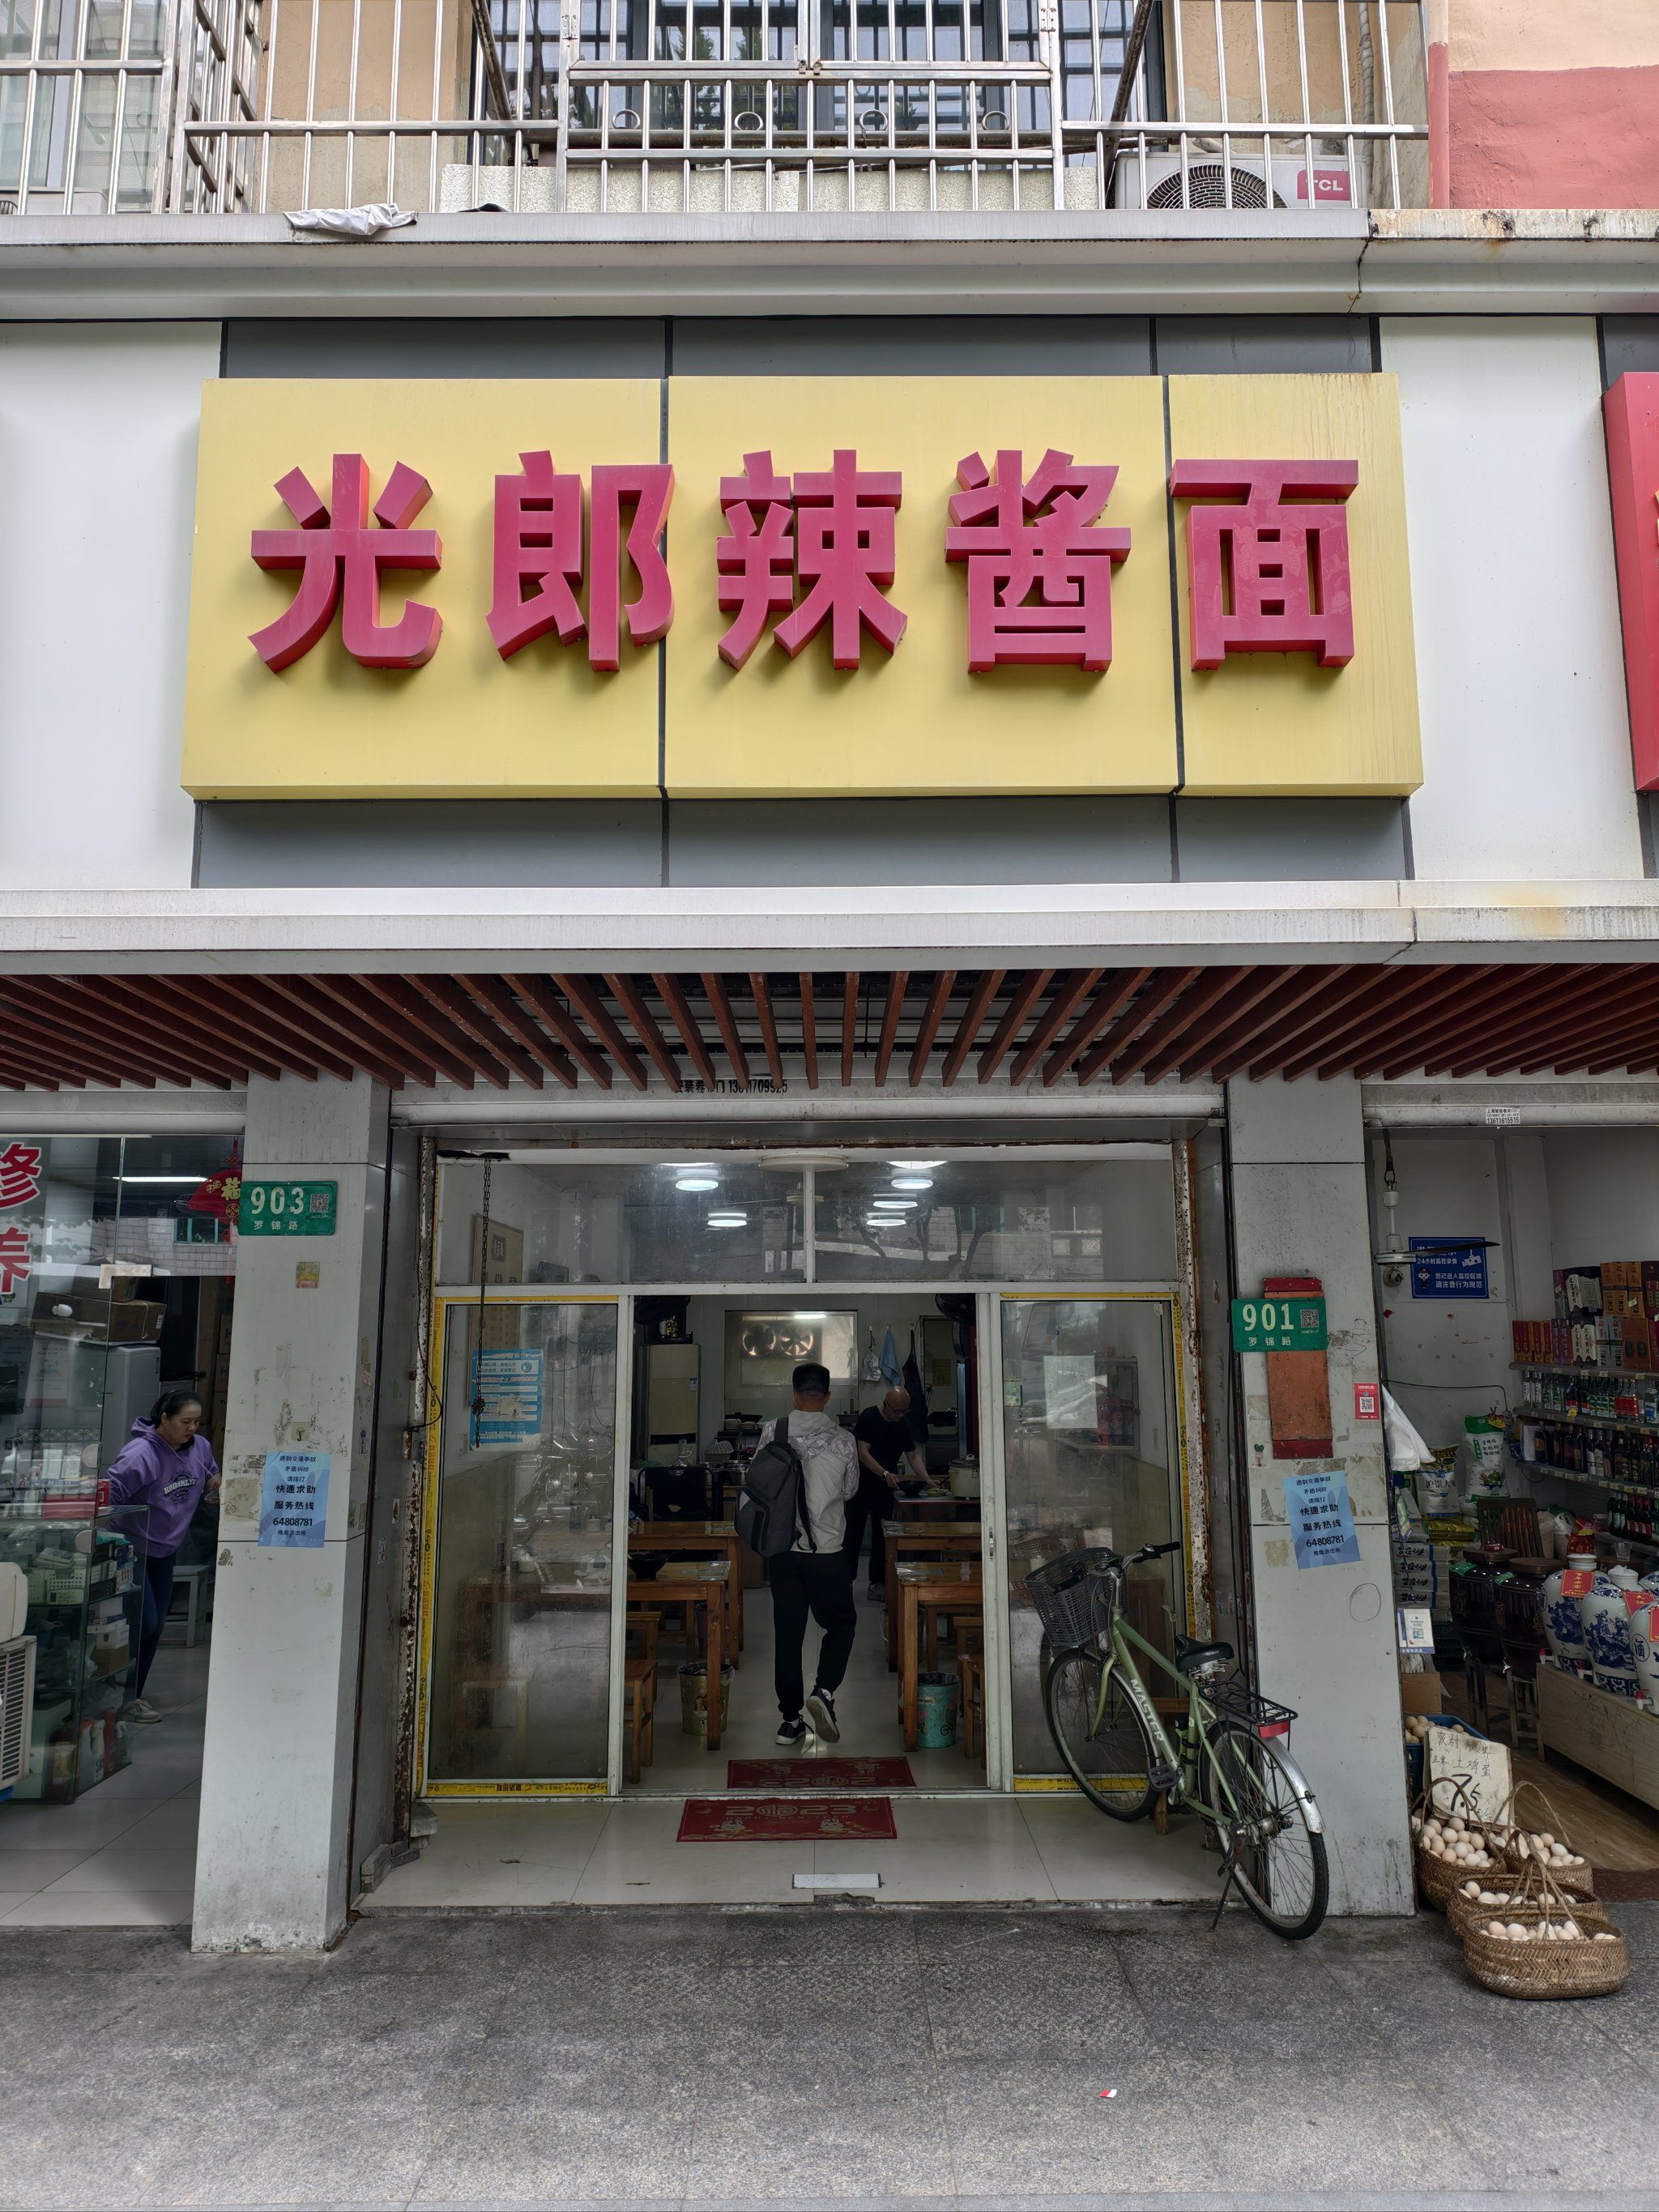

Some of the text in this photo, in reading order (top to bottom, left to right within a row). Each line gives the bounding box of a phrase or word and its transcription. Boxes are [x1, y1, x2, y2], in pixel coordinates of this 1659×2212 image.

[247, 450, 1359, 673] 光郎辣酱面
[674, 1079, 725, 1093] 装卷门
[250, 1187, 304, 1215] 903
[254, 1221, 298, 1230] 罗锦路
[1242, 1303, 1294, 1332] 901
[1248, 1336, 1291, 1346] 罗锦路
[275, 1485, 316, 1494] 快速求助
[274, 1501, 314, 1510] 服务热线
[1300, 1504, 1338, 1516] 快速求助
[272, 1518, 313, 1527] 64808781
[1303, 1519, 1341, 1532] 服务热线
[1306, 1535, 1345, 1548] 64808781
[1130, 1678, 1165, 1741] MASTER
